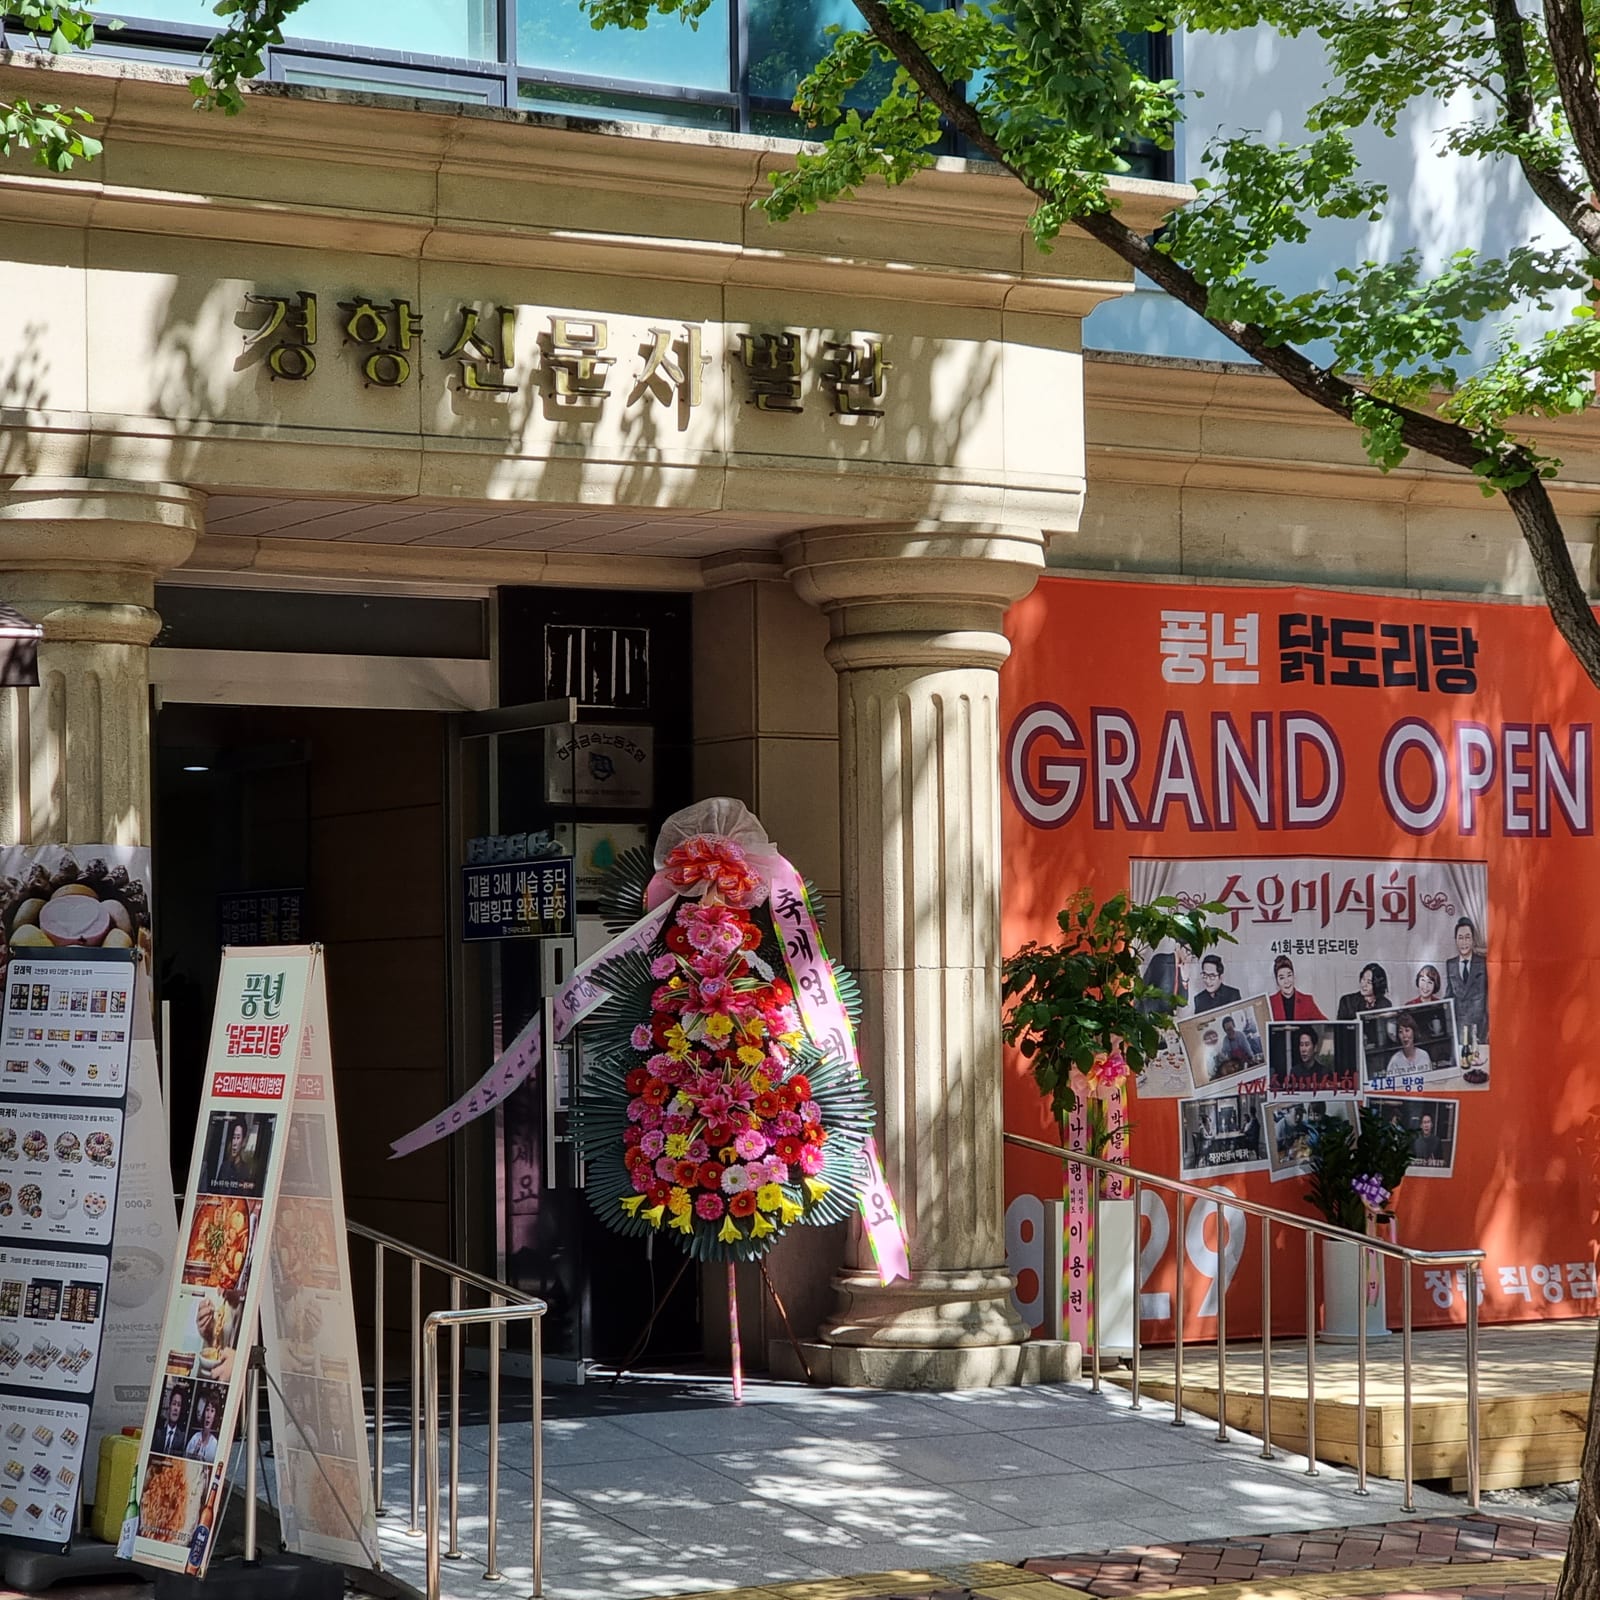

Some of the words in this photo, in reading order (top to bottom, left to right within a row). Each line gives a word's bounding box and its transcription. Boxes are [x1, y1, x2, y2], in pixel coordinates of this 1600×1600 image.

[1160, 609, 1260, 685] 풍년
[1278, 612, 1479, 695] 닭도리탕
[1006, 701, 1345, 832] GRAND
[1378, 715, 1594, 838] OPEN
[468, 874, 490, 898] 재벌
[493, 872, 512, 896] 3세
[515, 870, 539, 894] 세습
[542, 868, 567, 893] 중단
[1216, 869, 1417, 932] 수요미식회
[468, 899, 513, 924] 재벌횡포
[516, 897, 539, 921] 완전
[543, 895, 567, 920] 끝장
[1317, 939, 1360, 955] 닭도리탕
[241, 971, 285, 1020] 풍년
[1402, 1076, 1425, 1092] 방영
[1498, 1262, 1597, 1304] 직영점
